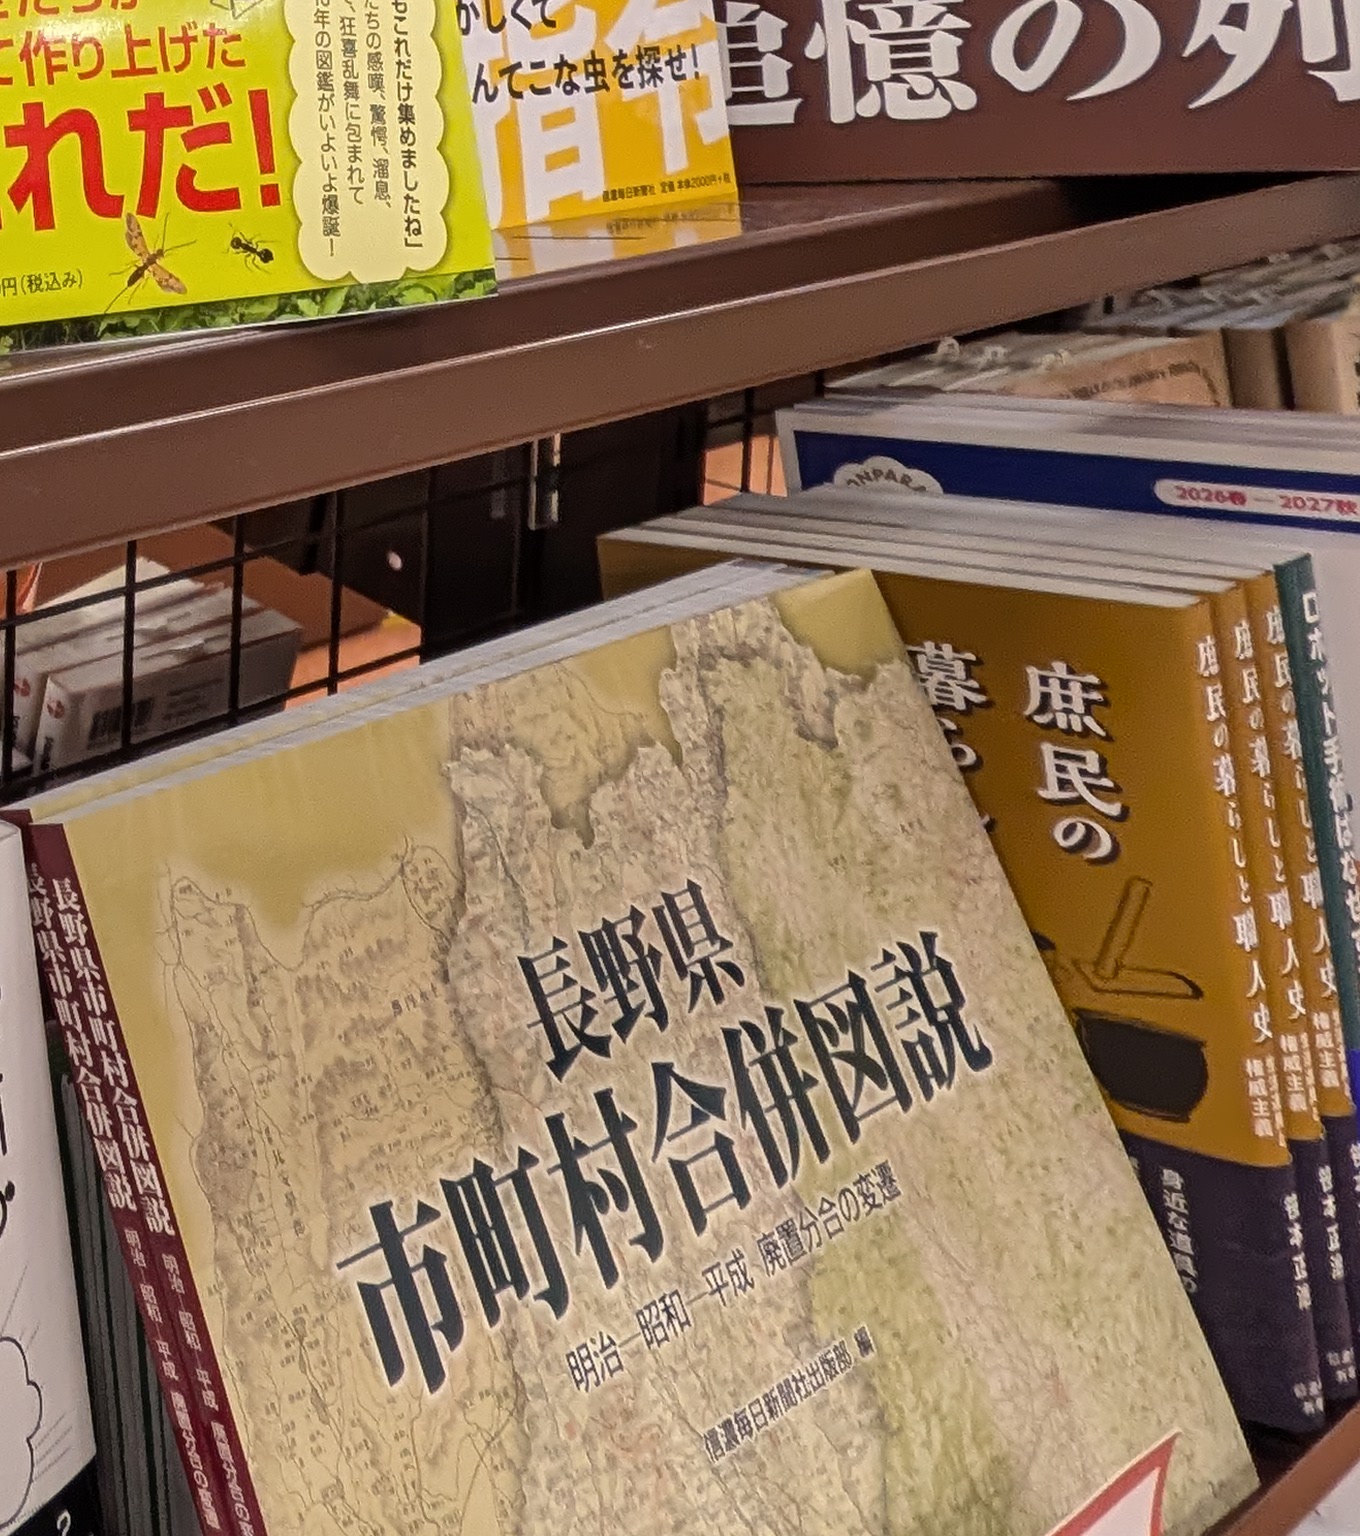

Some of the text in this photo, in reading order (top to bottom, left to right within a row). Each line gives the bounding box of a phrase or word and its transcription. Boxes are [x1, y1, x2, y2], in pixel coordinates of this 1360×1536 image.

[471, 42, 703, 105] んてこな虫を探せ!
[1023, 662, 1121, 862] 庶民の
[51, 878, 176, 1237] 長野県市町村合併図説
[516, 877, 747, 1083] 長野県
[336, 930, 994, 1396] 市町村合併図説
